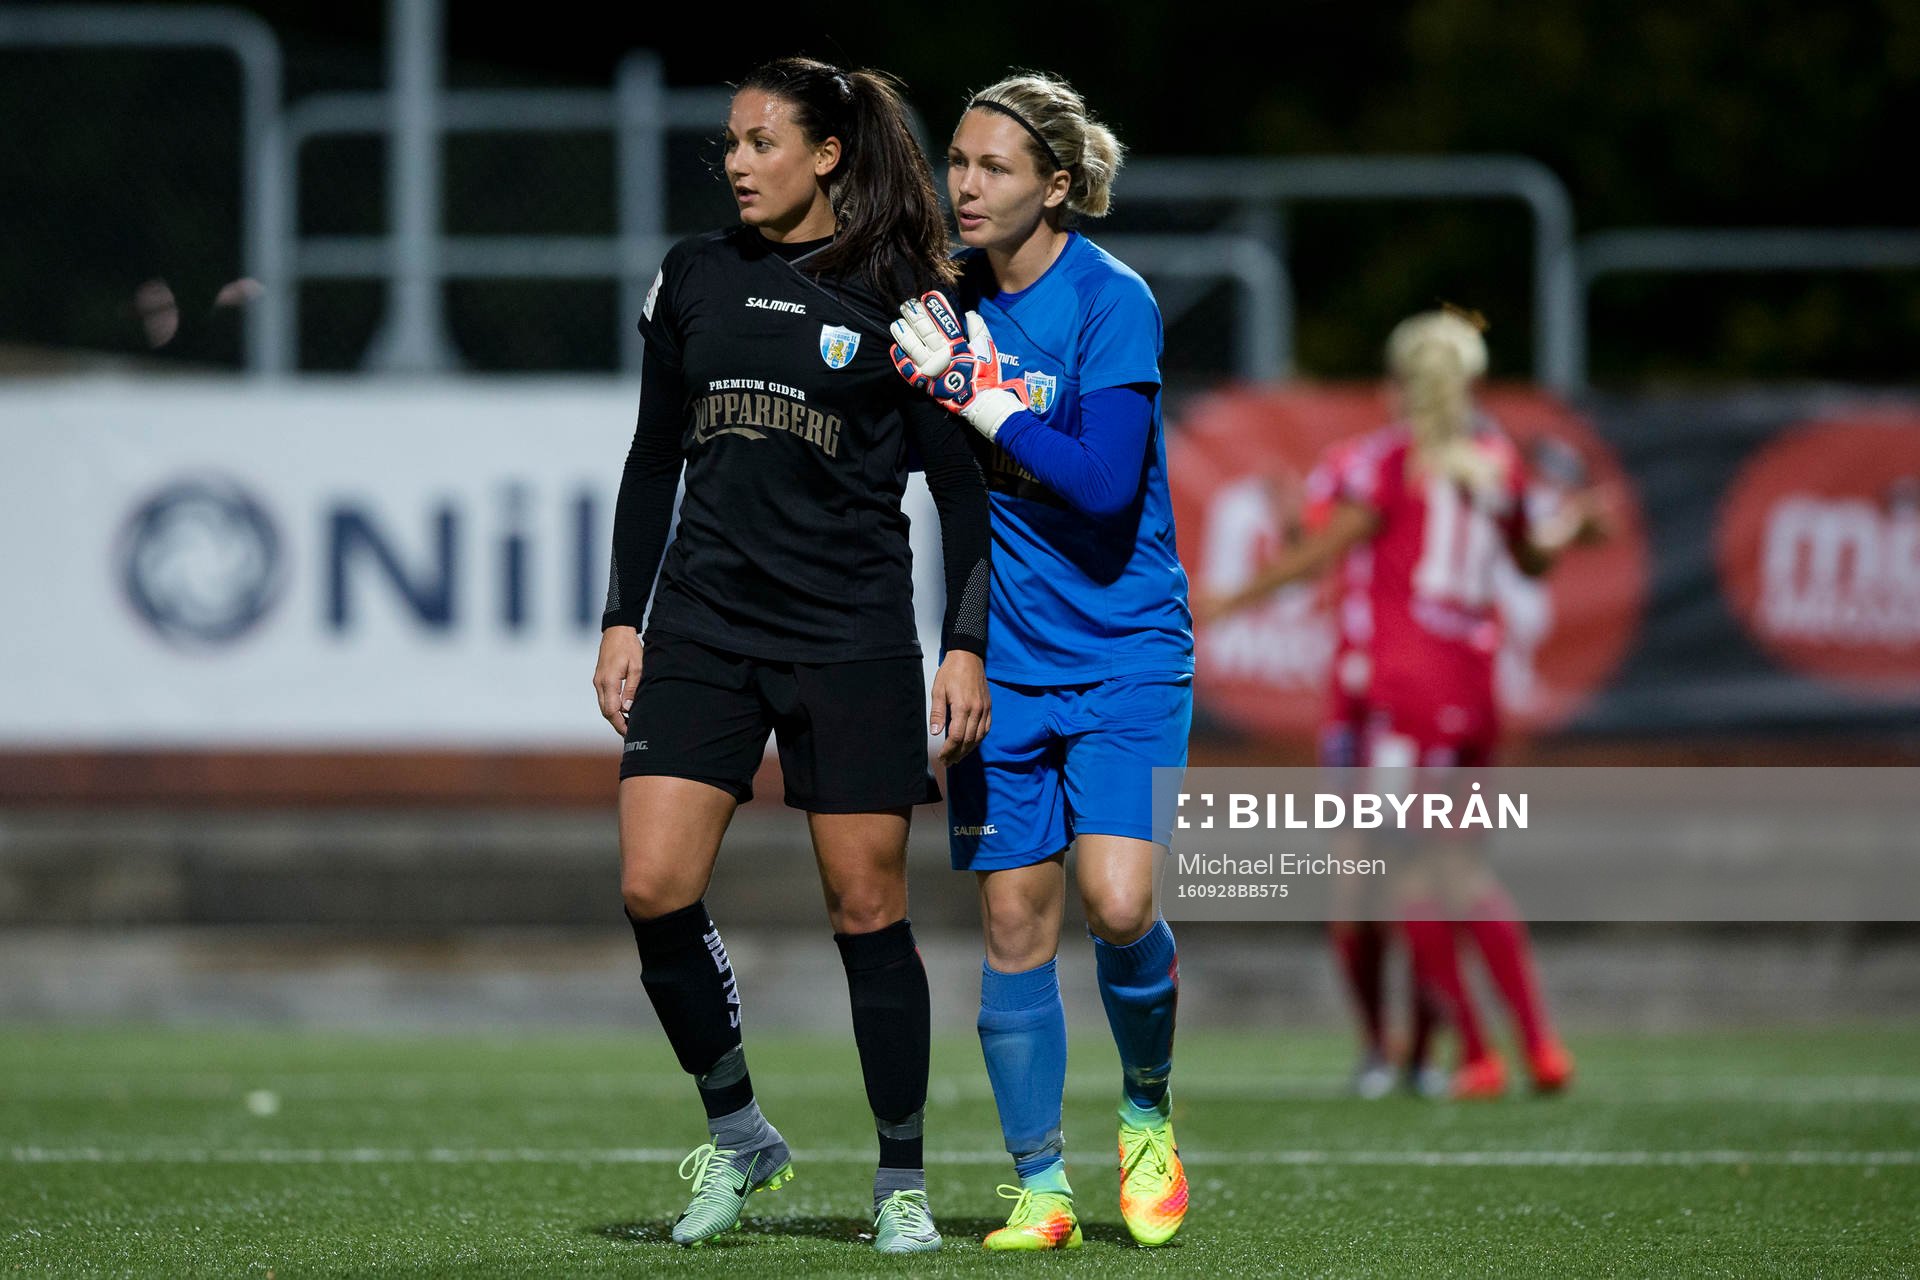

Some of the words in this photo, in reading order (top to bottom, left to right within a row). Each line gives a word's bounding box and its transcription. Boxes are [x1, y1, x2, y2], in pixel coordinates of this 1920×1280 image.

[926, 298, 960, 336] SELECT
[709, 378, 764, 391] PREMIUM
[768, 382, 806, 401] CIDER
